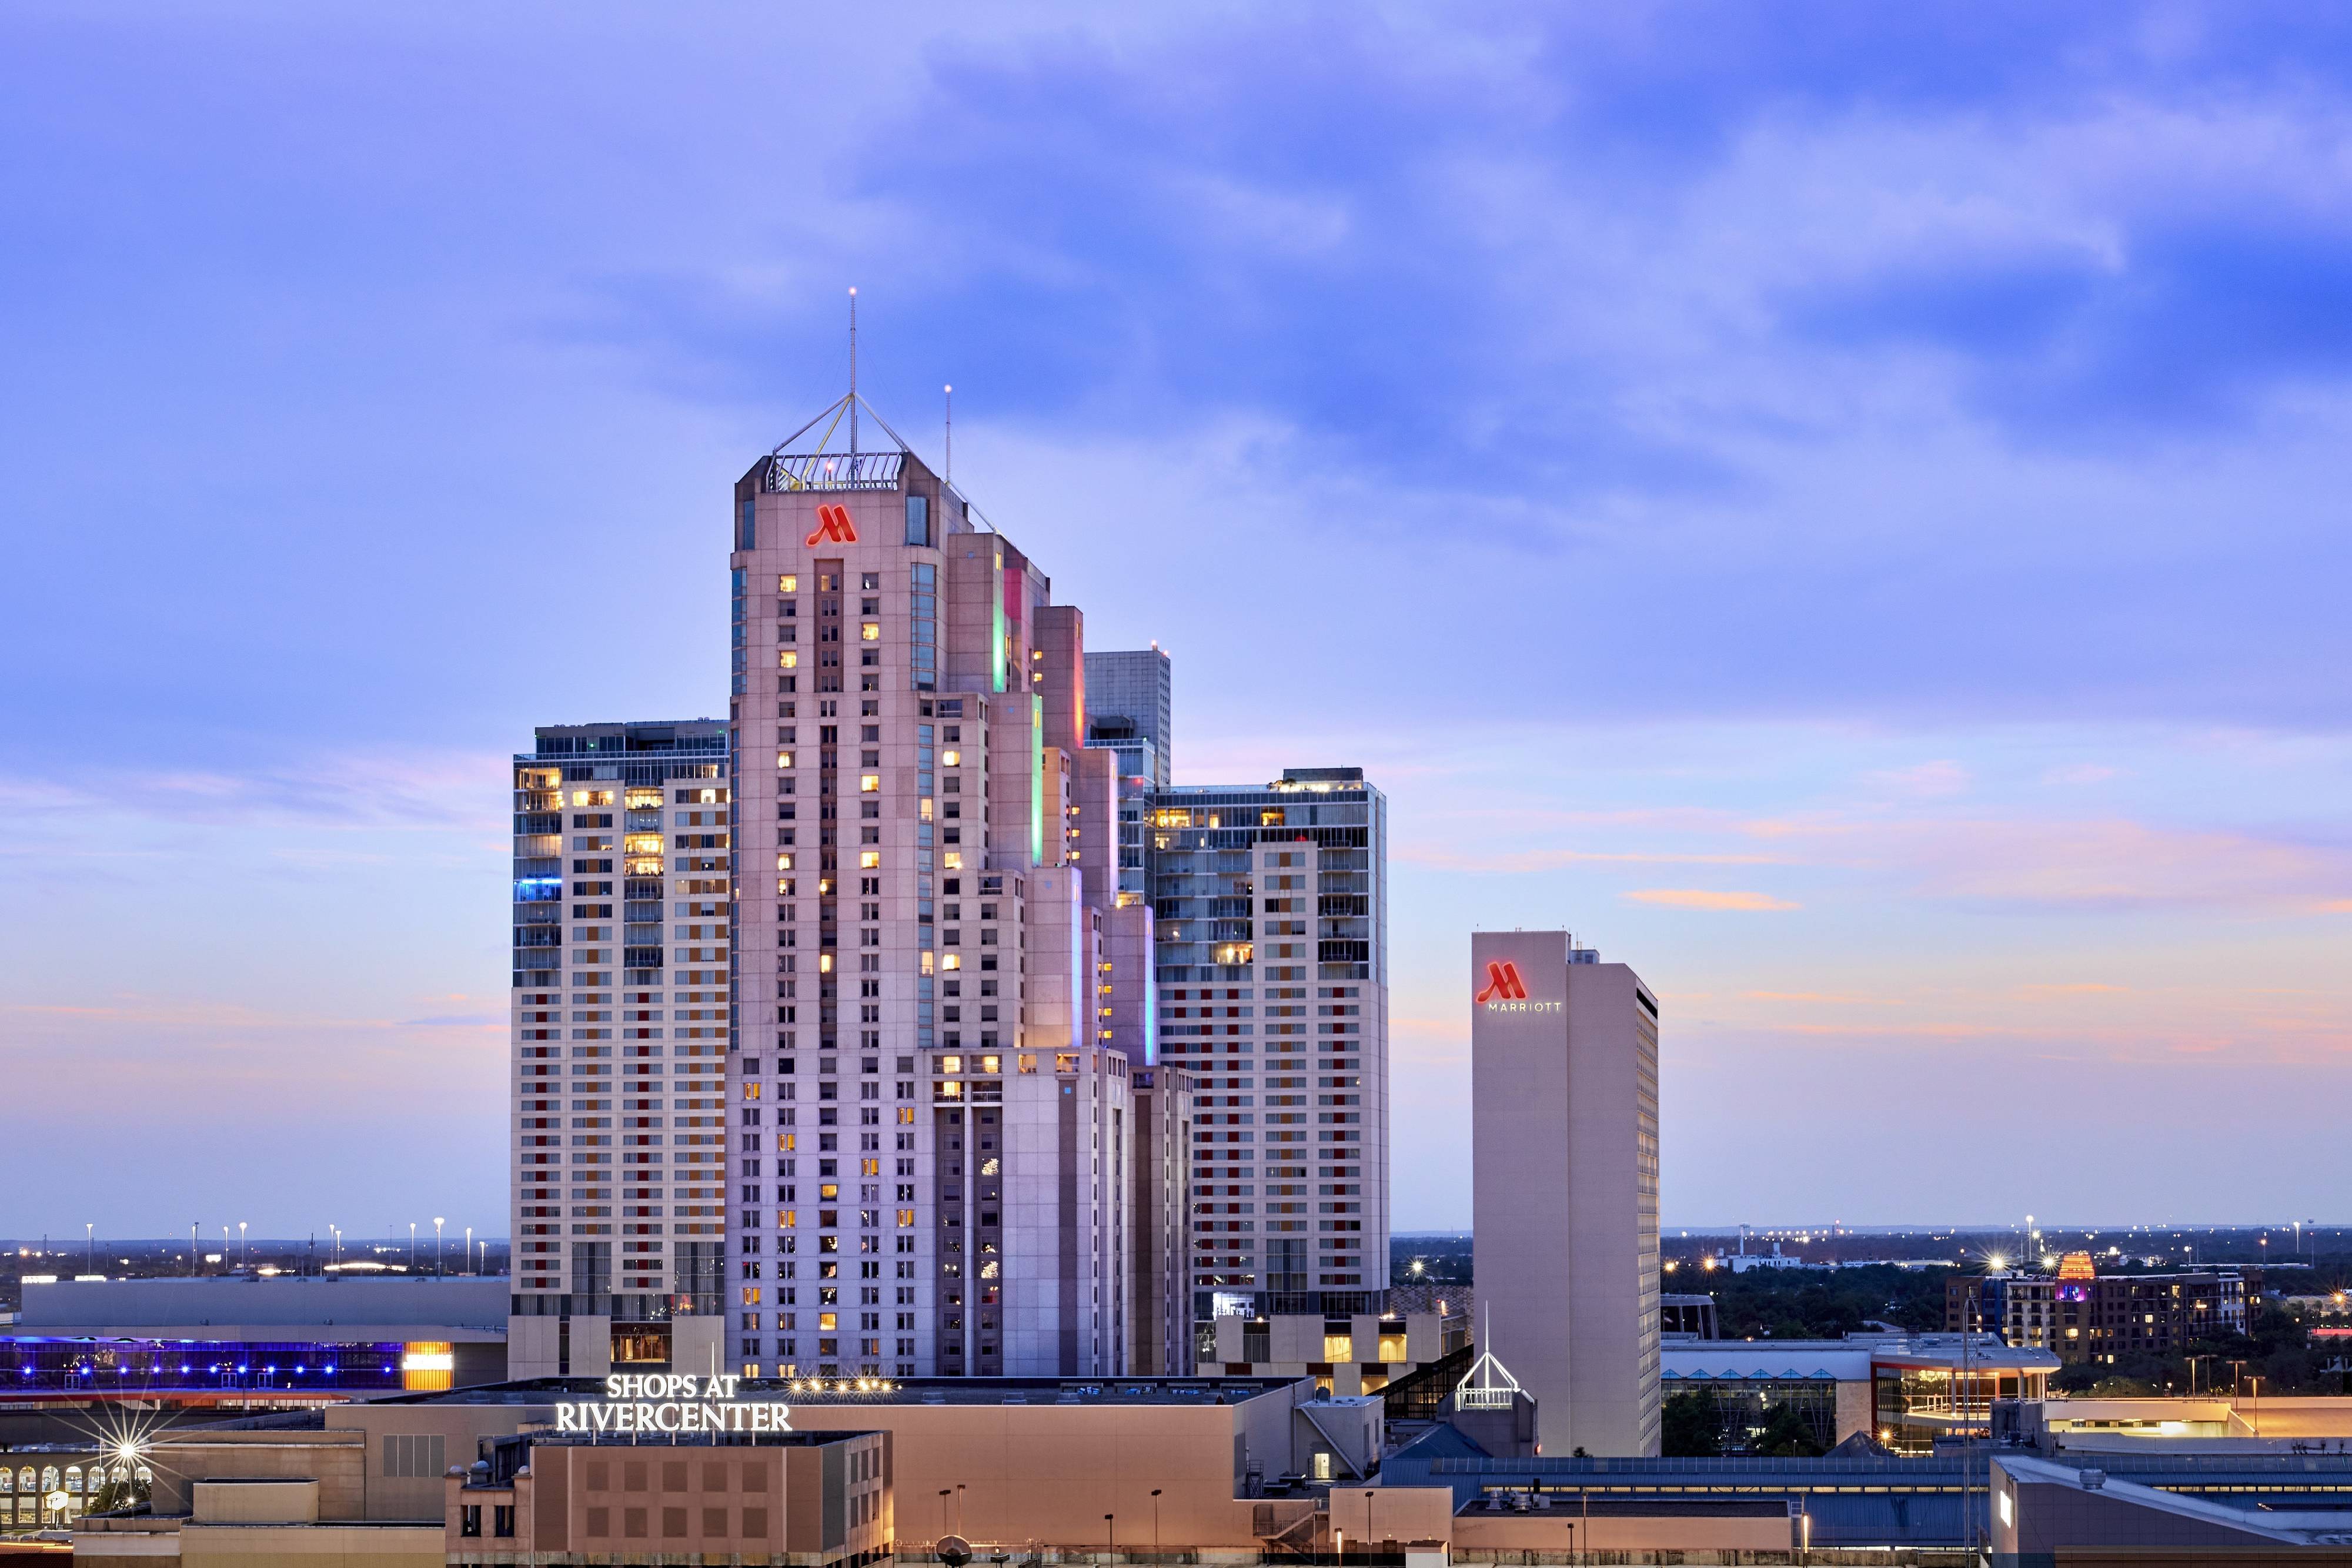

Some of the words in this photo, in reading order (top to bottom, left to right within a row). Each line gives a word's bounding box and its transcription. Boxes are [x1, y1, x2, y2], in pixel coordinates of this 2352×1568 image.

[1488, 1002, 1561, 1012] MARRIOTT
[607, 1374, 697, 1398] SHOPS
[704, 1375, 740, 1398] AT
[556, 1403, 793, 1432] RIVERCENTER
